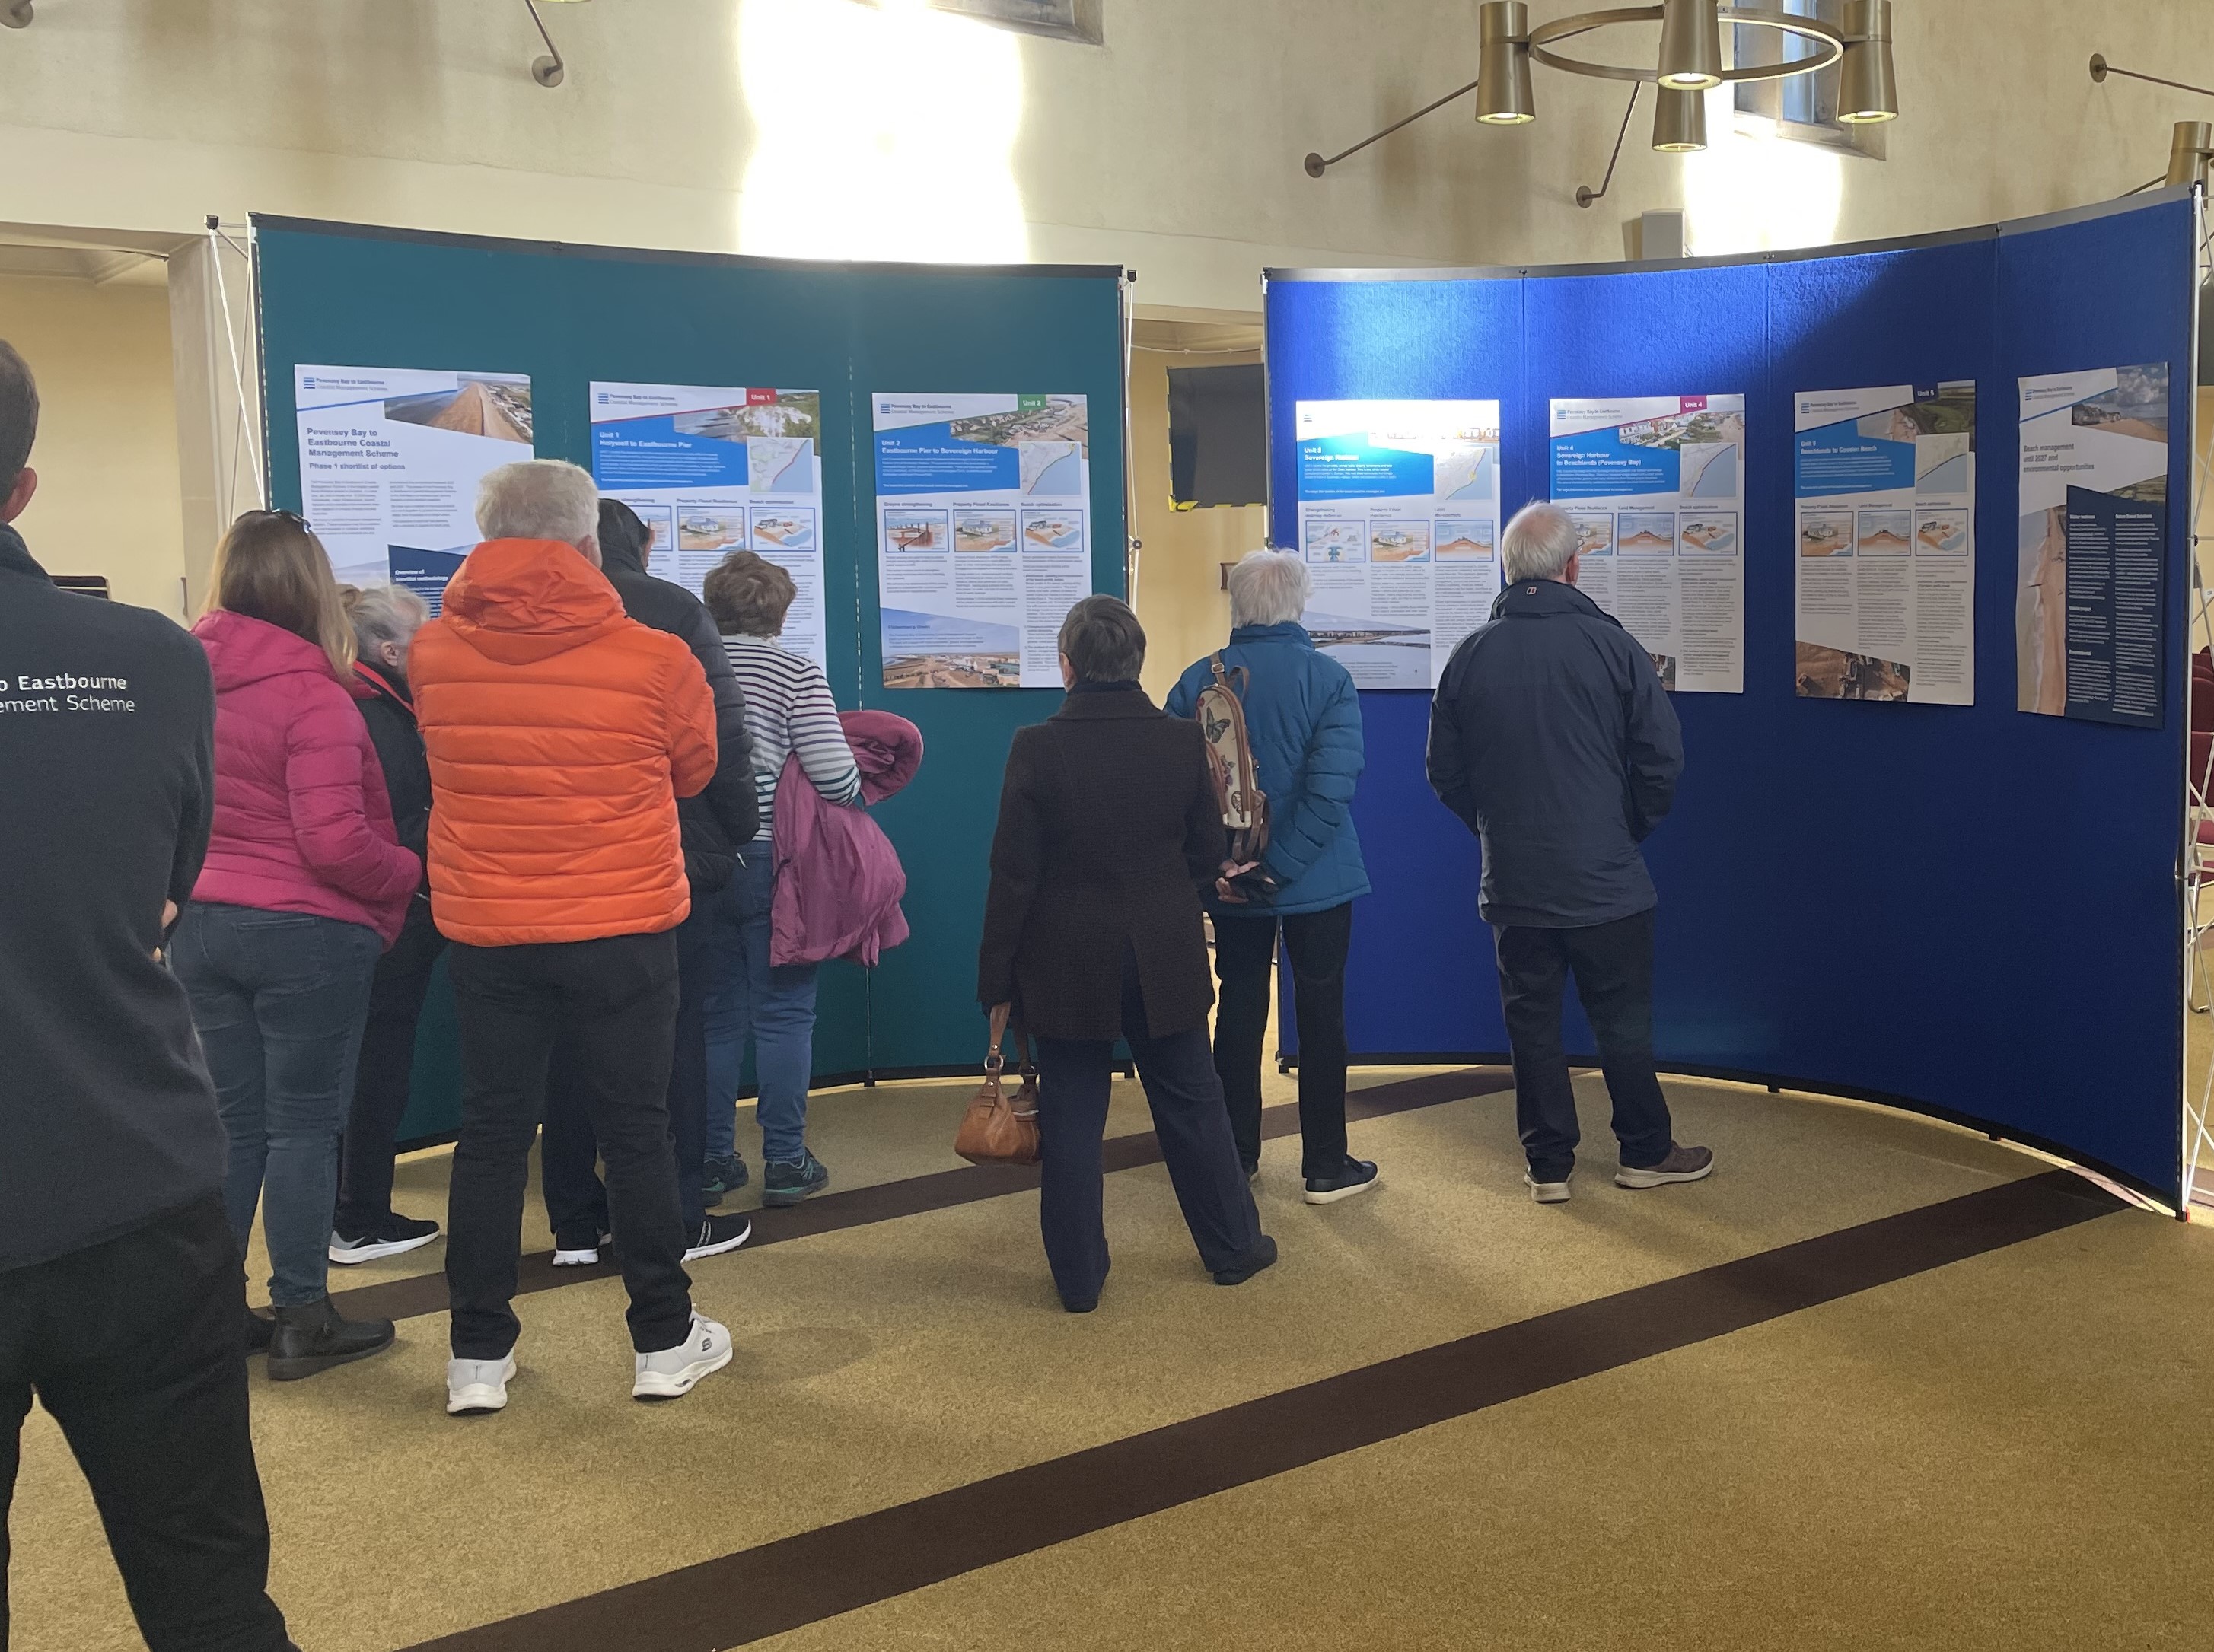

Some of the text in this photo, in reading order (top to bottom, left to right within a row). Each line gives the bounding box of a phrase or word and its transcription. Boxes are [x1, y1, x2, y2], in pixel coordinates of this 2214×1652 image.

[307, 428, 349, 438] Pevensey
[351, 428, 367, 438] Bay
[307, 438, 358, 447] Eastbourne
[2040, 444, 2075, 452] management
[308, 449, 364, 458] Management
[2023, 463, 2095, 473] environmental opportunities
[0, 673, 127, 692] o Eastbourne
[0, 695, 135, 713] ement Scheme
